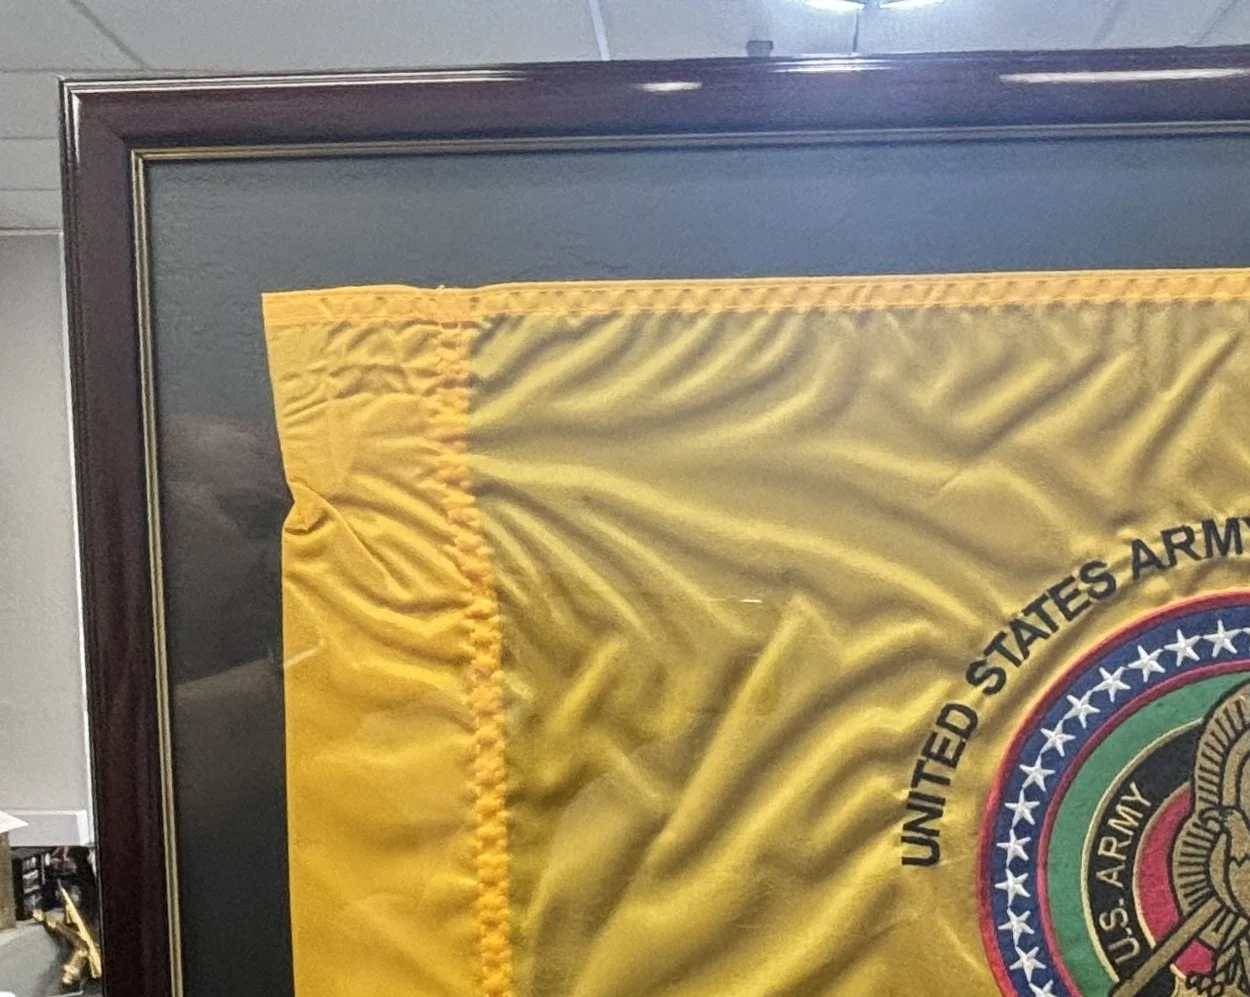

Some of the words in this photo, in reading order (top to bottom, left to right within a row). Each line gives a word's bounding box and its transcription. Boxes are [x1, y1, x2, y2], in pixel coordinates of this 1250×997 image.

[901, 701, 979, 869] UNITED
[966, 558, 1116, 696] STATES
[1097, 781, 1151, 888] ARMY
